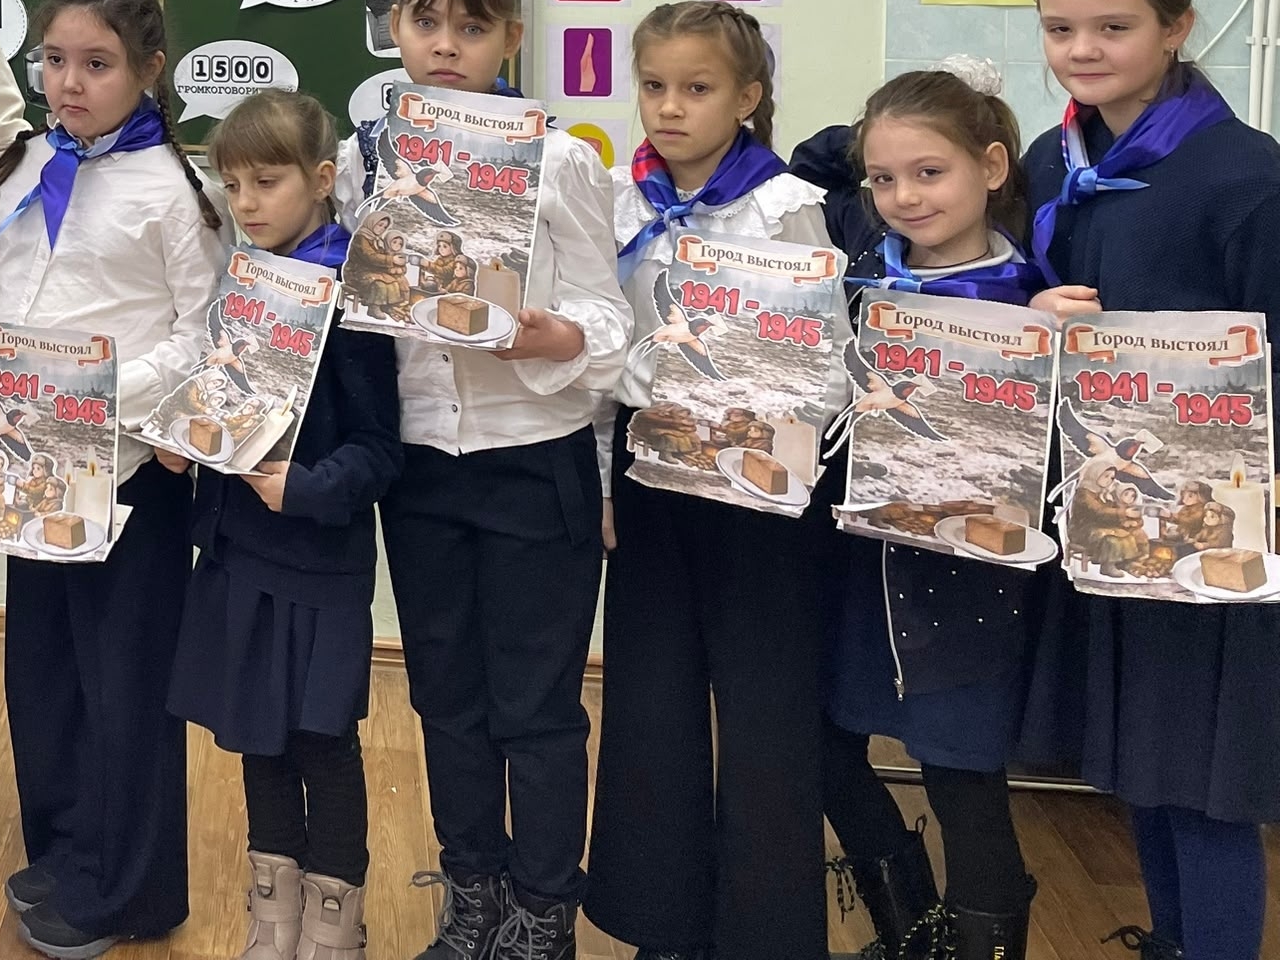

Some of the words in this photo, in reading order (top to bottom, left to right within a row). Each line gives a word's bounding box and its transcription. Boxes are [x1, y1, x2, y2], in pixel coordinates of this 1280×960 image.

[194, 58, 271, 80] 1500
[420, 103, 461, 124] Город
[464, 112, 524, 132] выстоял
[394, 133, 452, 165] 1941
[466, 162, 529, 195] 1945
[700, 244, 743, 264] Город
[747, 252, 812, 272] выстоял
[245, 262, 277, 283] Город
[276, 273, 316, 296] выстоял
[223, 293, 265, 324] 1941
[269, 323, 315, 357] 1945
[679, 280, 739, 315] 1941
[755, 311, 823, 346] 1945
[894, 311, 945, 334] Город
[947, 321, 1023, 347] выстоял
[1, 332, 36, 349] Город
[39, 339, 92, 355] выстоял
[1094, 331, 1145, 350] Город
[1151, 337, 1228, 352] выстоял
[872, 343, 941, 376] 1941
[960, 372, 1037, 411] 1945
[53, 394, 107, 425] 1945
[1074, 370, 1149, 402] 1941
[1173, 393, 1253, 425] 1945
